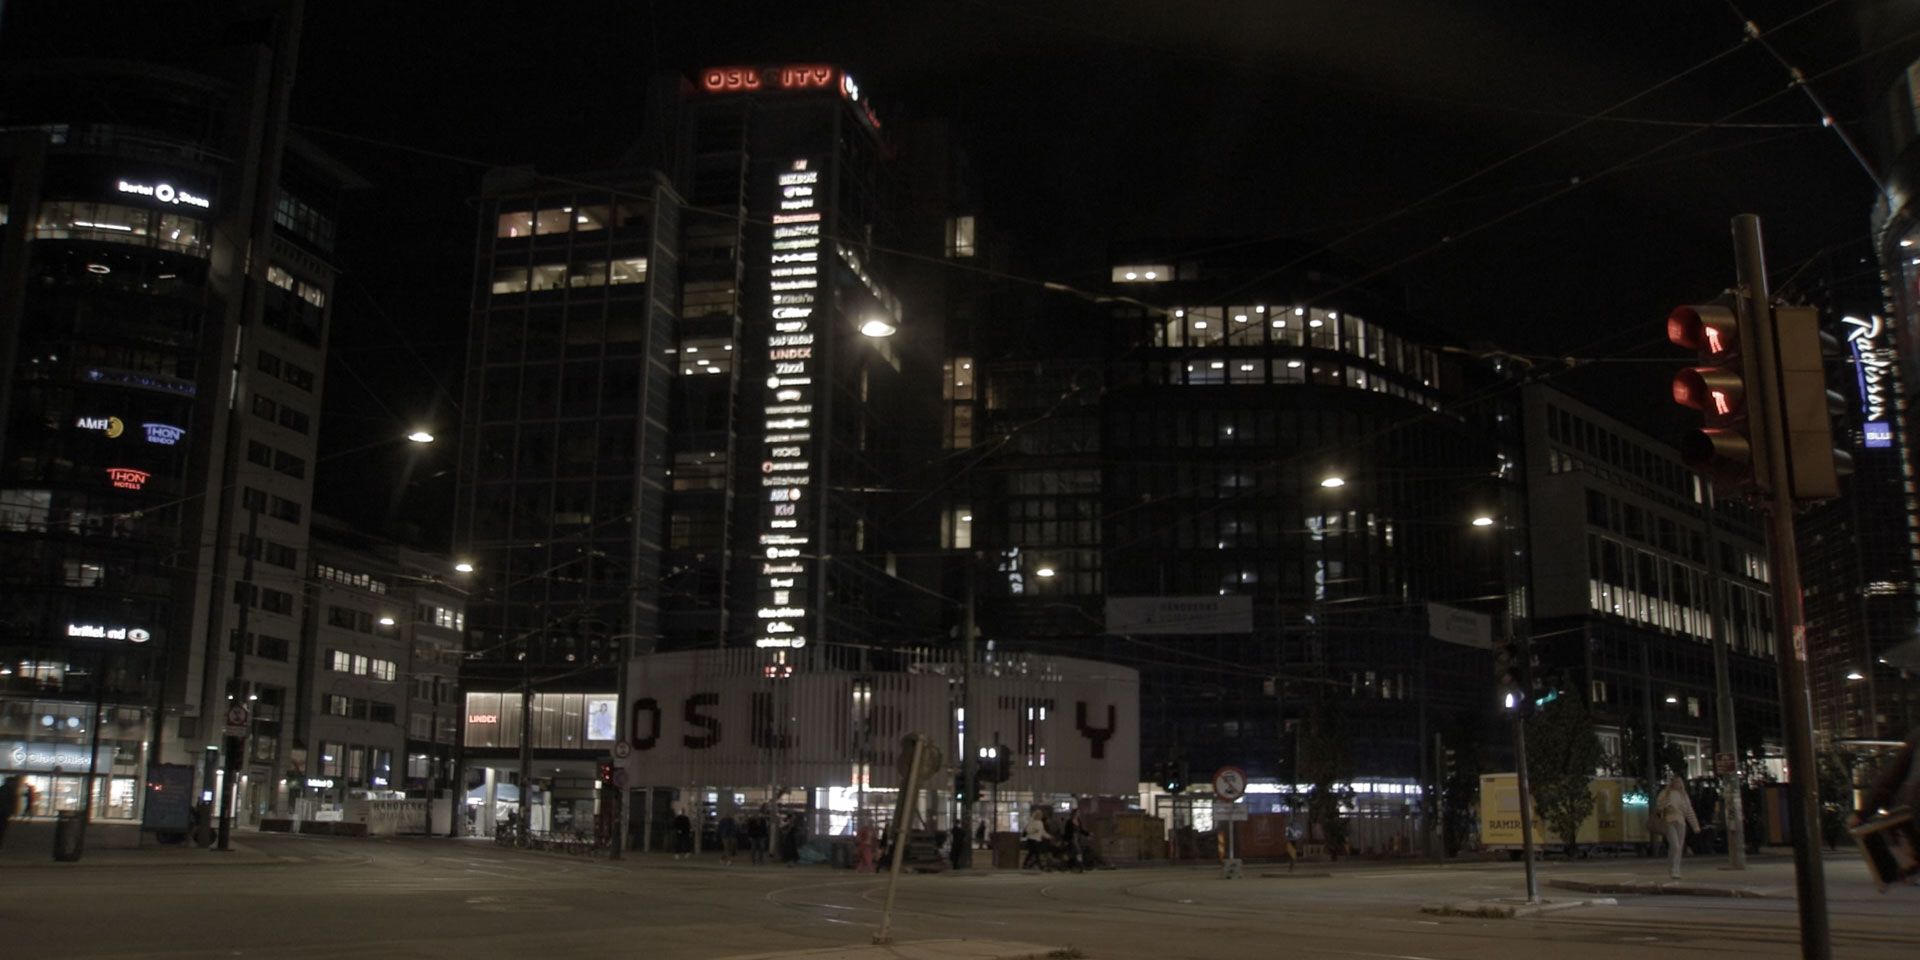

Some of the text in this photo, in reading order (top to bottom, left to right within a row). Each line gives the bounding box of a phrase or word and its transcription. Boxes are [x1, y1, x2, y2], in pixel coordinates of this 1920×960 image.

[770, 348, 812, 361] LINDEX
[1841, 314, 1890, 421] Radisson
[76, 418, 108, 431] AMFI
[142, 422, 186, 441] THON
[106, 468, 152, 484] THON
[113, 481, 141, 491] HOTELS
[469, 714, 497, 724] LINDEX
[1489, 819, 1538, 831] RAMIRT
